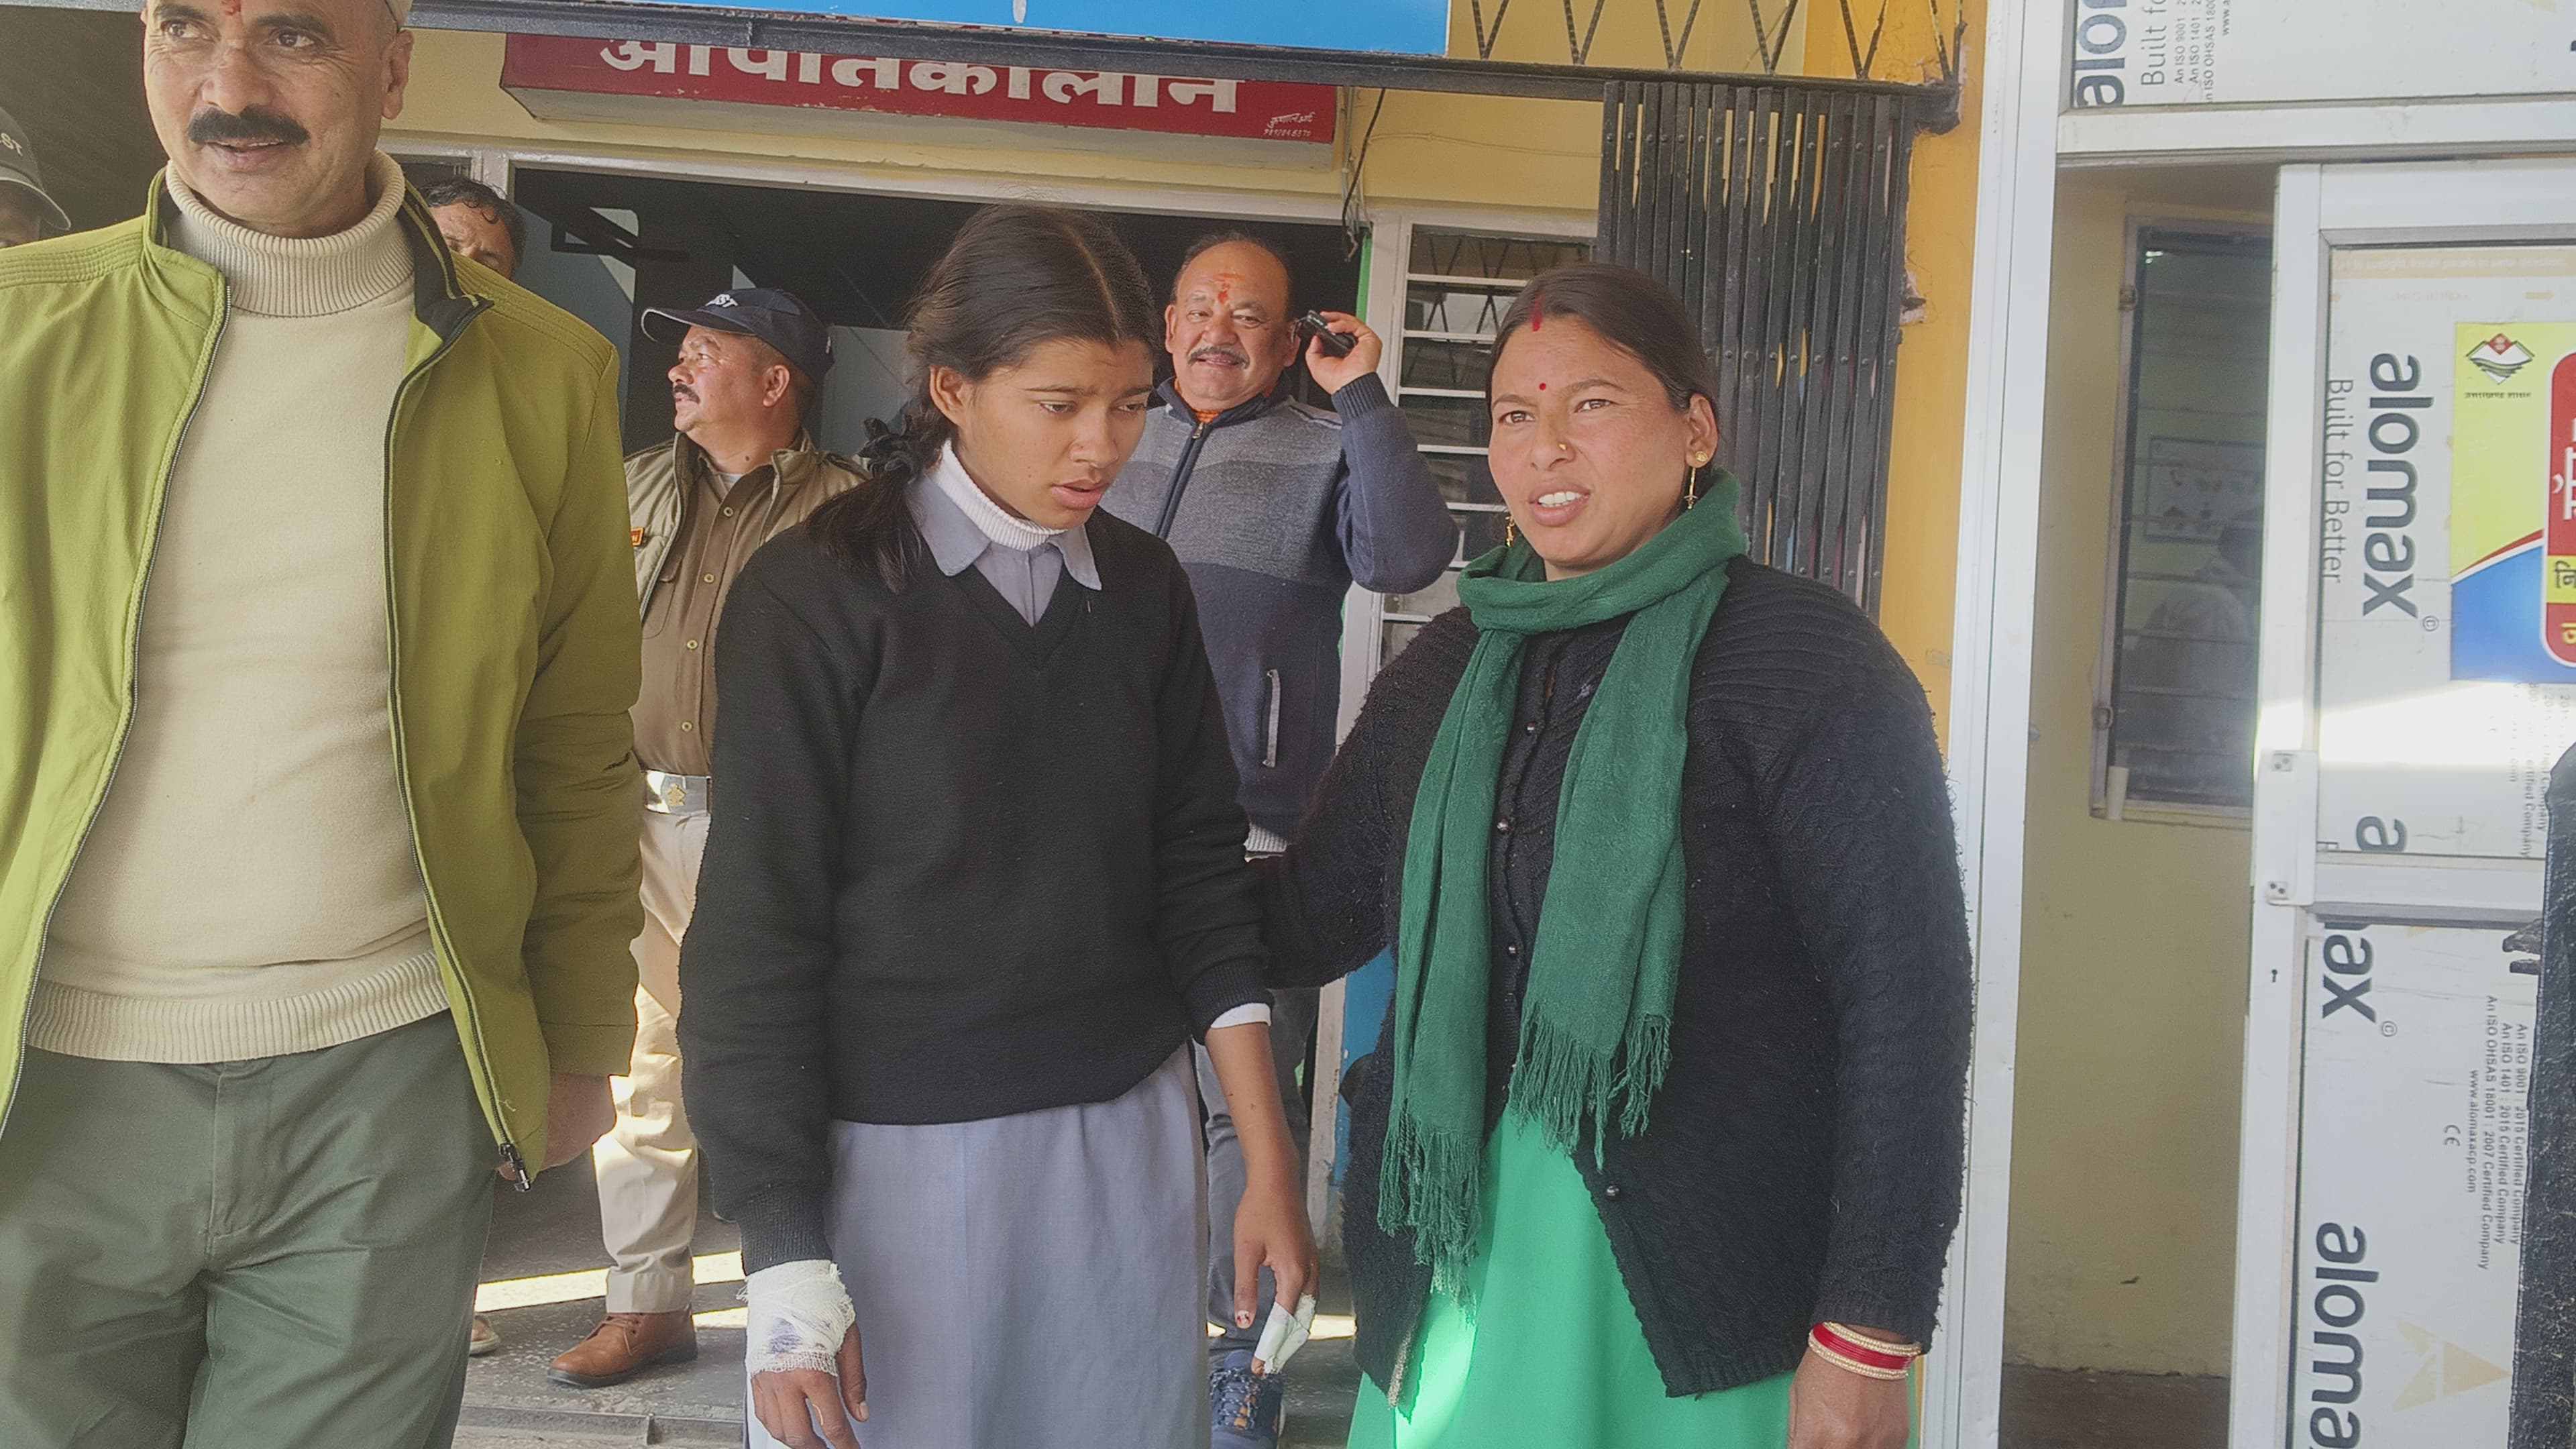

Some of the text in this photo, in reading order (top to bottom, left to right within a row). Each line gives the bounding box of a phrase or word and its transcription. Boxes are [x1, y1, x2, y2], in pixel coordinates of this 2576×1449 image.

[2190, 17, 2200, 41] 1401
[2140, 25, 2167, 86] Built
[2174, 45, 2185, 66] ISO
[2189, 44, 2200, 65] ISO
[2204, 25, 2215, 67] OHSAS
[2174, 68, 2185, 85] An
[2188, 68, 2199, 85] An
[2203, 70, 2214, 91] ISO
[2322, 379, 2354, 584] Built for Better
[2363, 353, 2434, 619] alomax
[2521, 803, 2536, 856] Company
[2486, 996, 2498, 1012] An
[2486, 1014, 2498, 1036] ISO
[2501, 1023, 2512, 1040] An
[2516, 1024, 2528, 1040] An
[2485, 1039, 2497, 1083] OHSAS
[2500, 1042, 2512, 1063] ISO
[2516, 1043, 2528, 1064] ISO
[2500, 1069, 2512, 1093] 1401
[2515, 1068, 2526, 1095] 9001
[2484, 1087, 2496, 1120] 18001
[2466, 1069, 2479, 1193] www.alomaxacp.com
[2483, 1131, 2494, 1158] 2007
[2498, 1135, 2510, 1185] Certified
[2512, 1136, 2525, 1187] Certified
[2481, 1161, 2494, 1211] Certified
[2494, 1189, 2509, 1244] Company
[2477, 1214, 2493, 1270] Company
[2309, 1222, 2379, 1449] aloma
